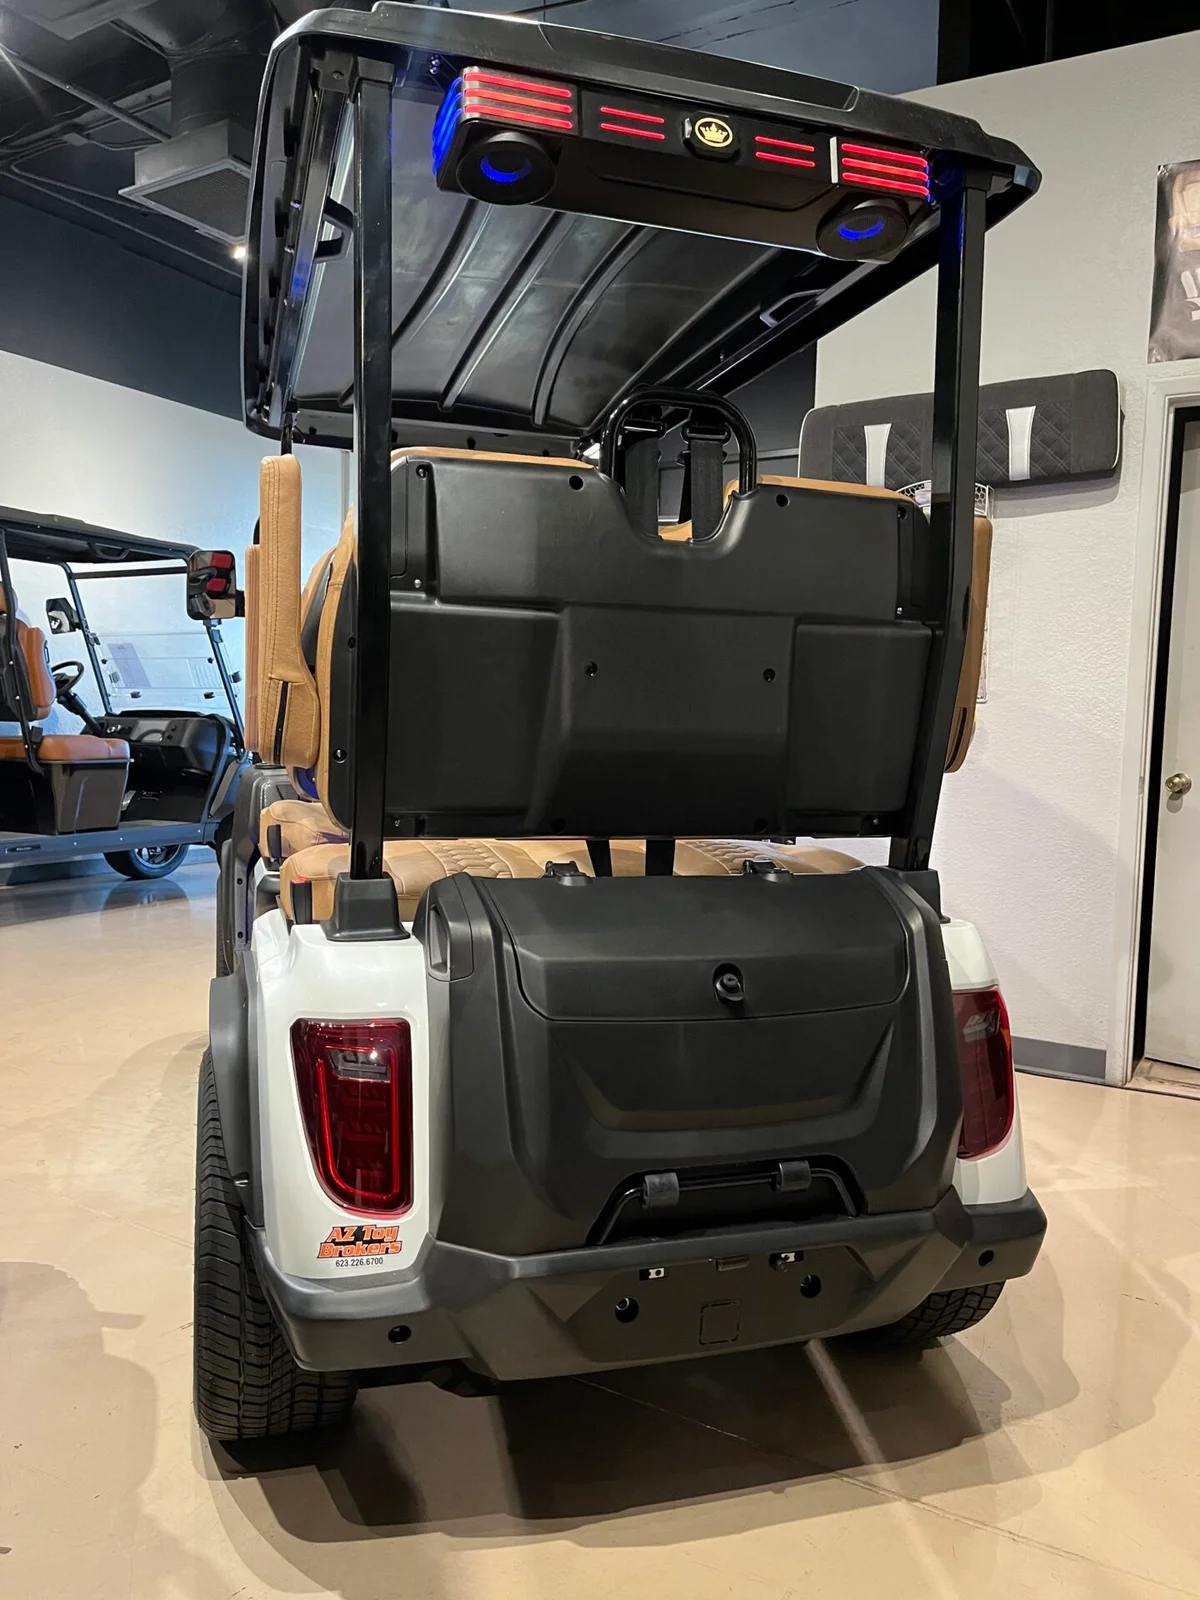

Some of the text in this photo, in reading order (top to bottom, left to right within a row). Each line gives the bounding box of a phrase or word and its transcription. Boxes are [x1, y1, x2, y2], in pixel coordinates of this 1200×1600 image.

[326, 1225, 398, 1242] AZ Toy
[318, 1241, 402, 1257] Brokers
[335, 1257, 384, 1268] 623.226.6700
